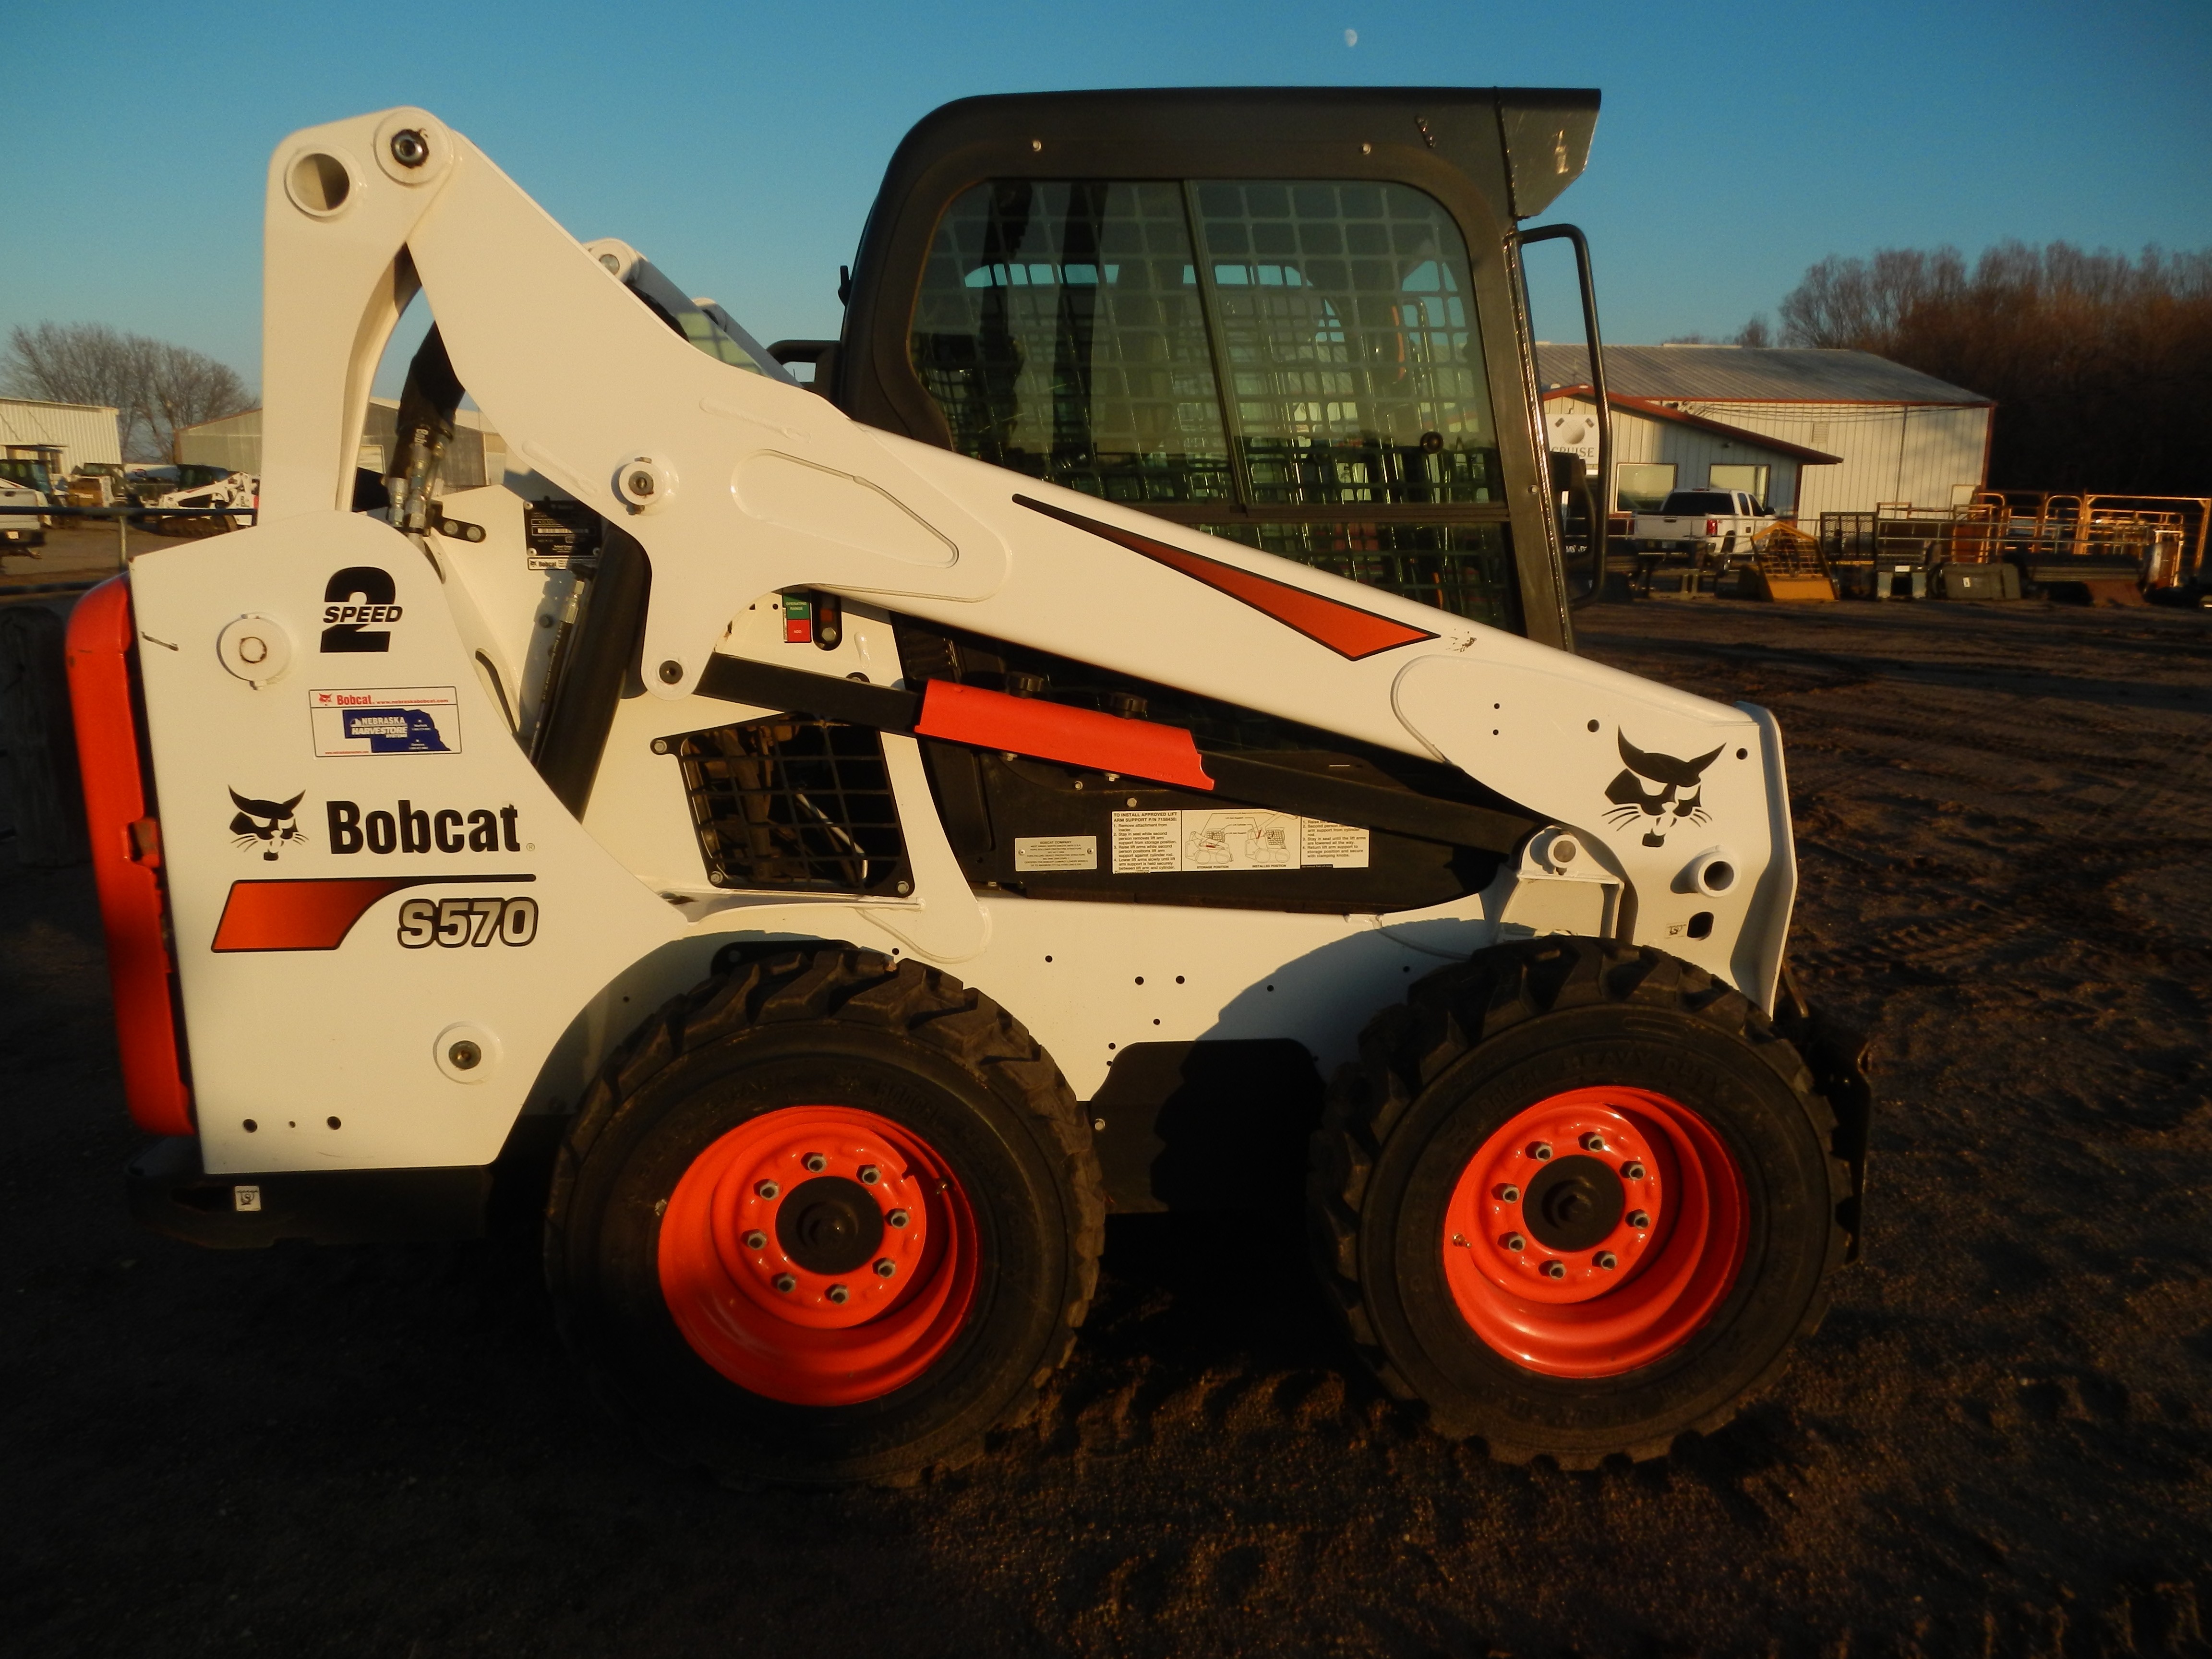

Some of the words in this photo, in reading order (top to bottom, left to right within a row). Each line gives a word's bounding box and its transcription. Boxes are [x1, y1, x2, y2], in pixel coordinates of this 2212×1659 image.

[320, 566, 397, 653] 2
[323, 606, 403, 624] SPEED
[337, 695, 372, 705] Bobcat
[361, 717, 405, 725] NEBRASKA
[352, 726, 408, 735] HARVESTORE
[327, 800, 521, 854] Bobcat
[397, 897, 539, 948] S570
